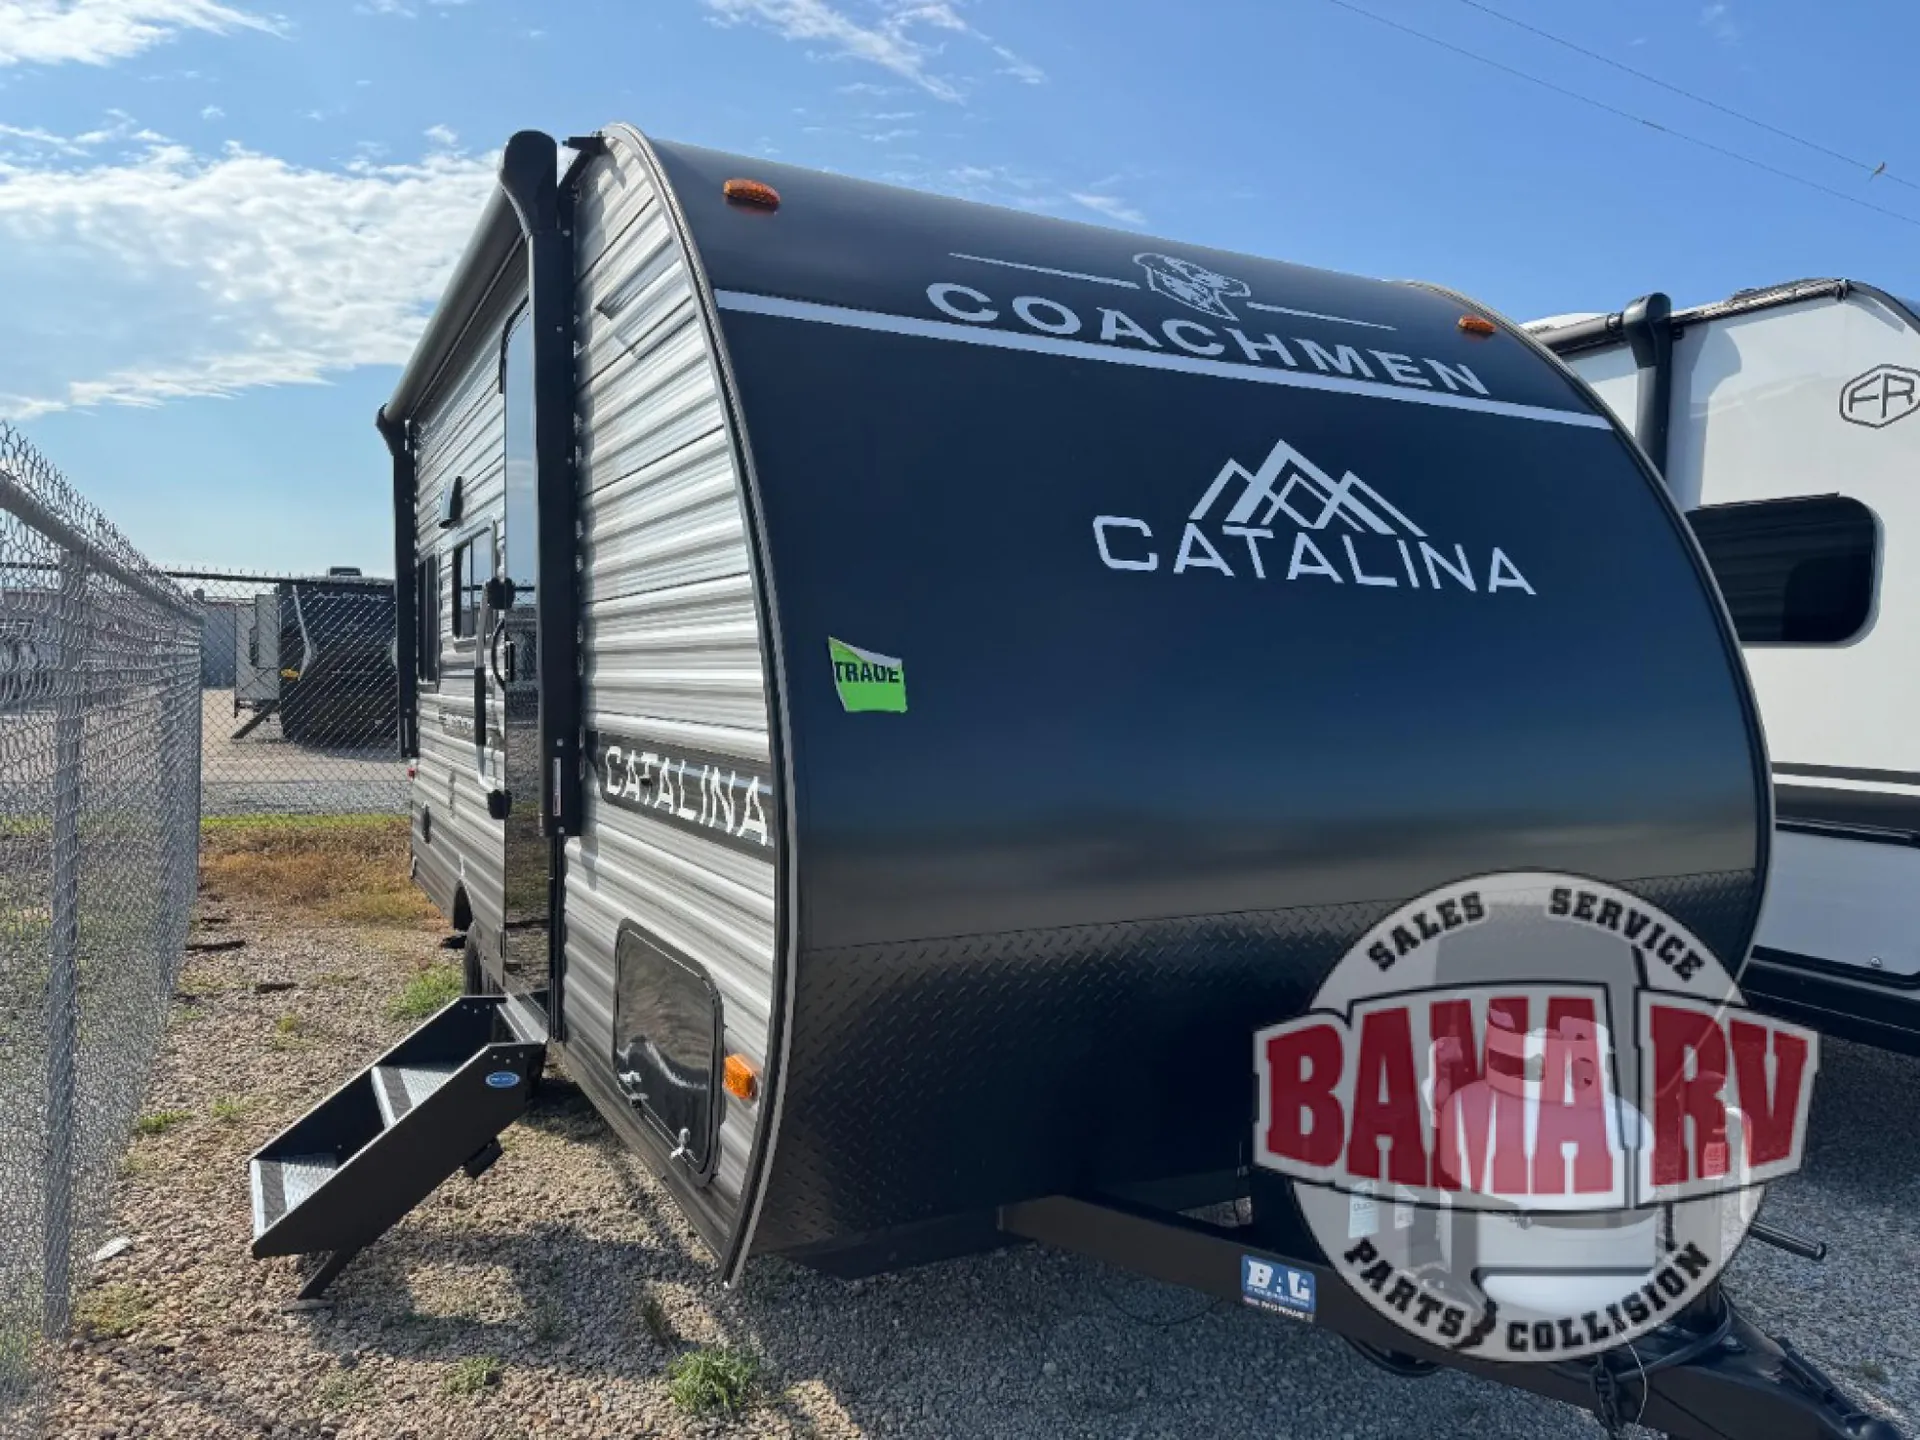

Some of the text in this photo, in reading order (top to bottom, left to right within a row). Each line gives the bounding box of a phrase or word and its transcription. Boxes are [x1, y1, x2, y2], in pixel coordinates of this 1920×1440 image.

[926, 282, 1491, 396] COACHMEN
[1092, 515, 1536, 595] CATALINA
[835, 661, 901, 683] TRADE
[605, 746, 767, 846] CATALINA
